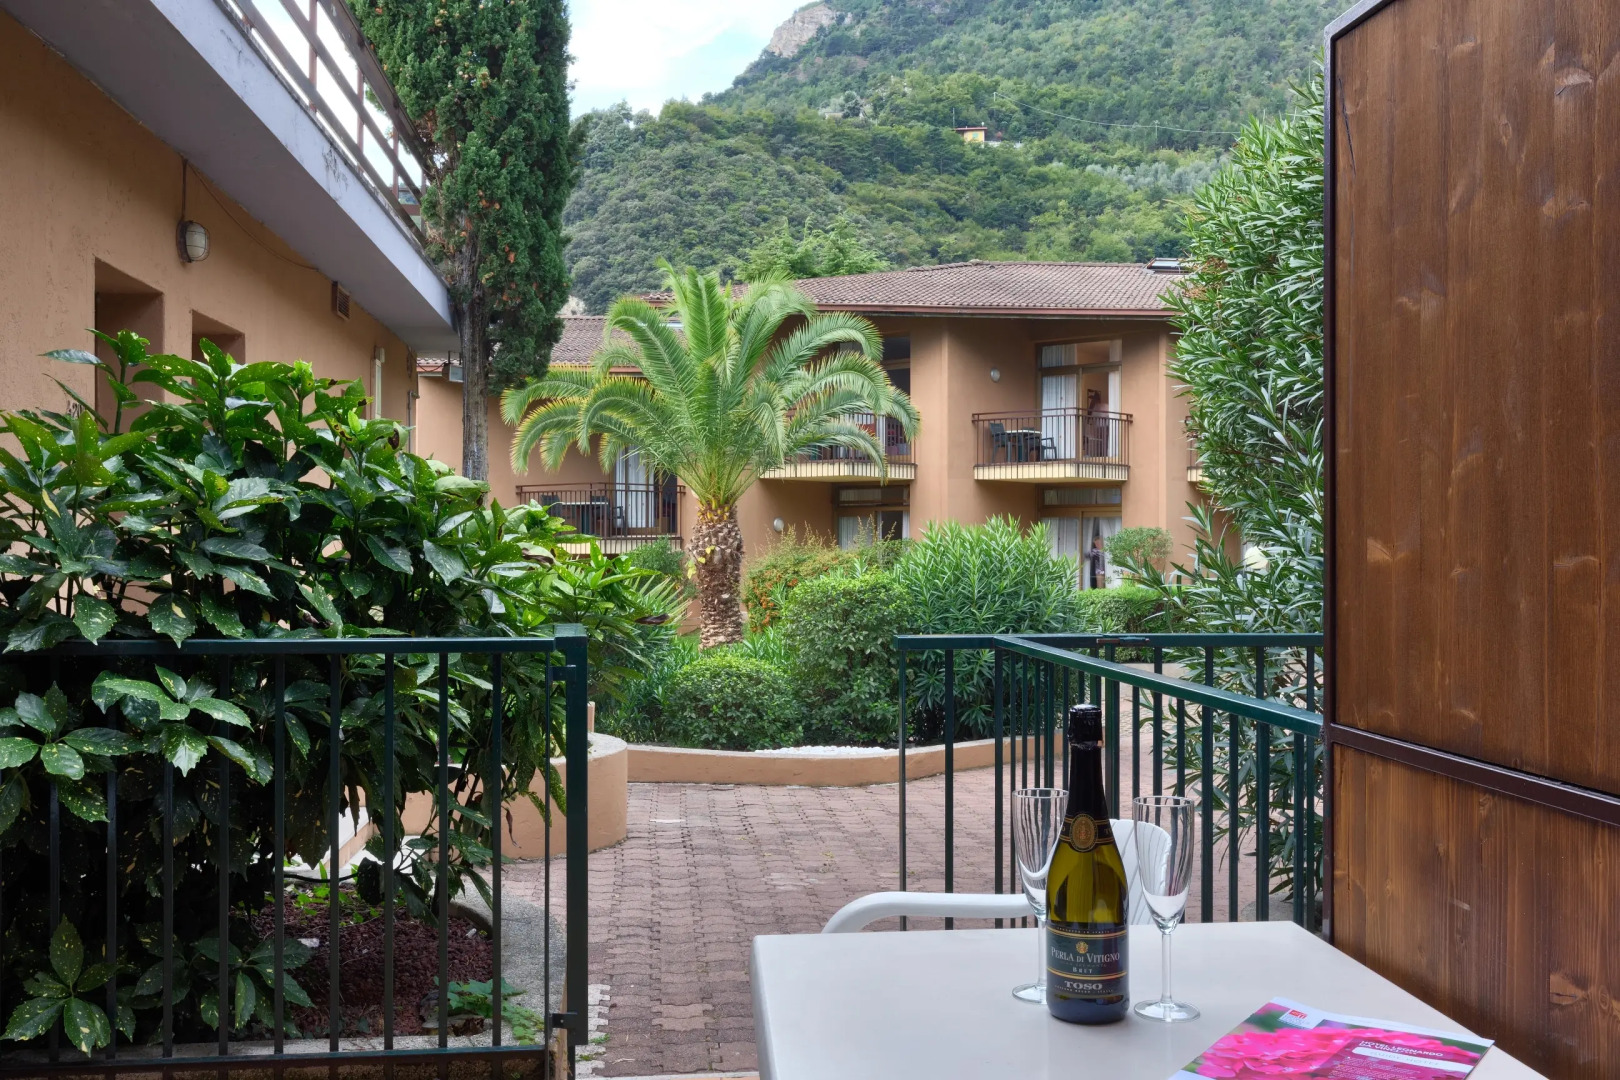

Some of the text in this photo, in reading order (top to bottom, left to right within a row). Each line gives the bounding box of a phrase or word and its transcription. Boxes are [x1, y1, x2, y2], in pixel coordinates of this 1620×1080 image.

[1051, 946, 1120, 963] PERLA DI VITIGNO
[1072, 966, 1093, 974] BRUT
[1064, 980, 1103, 990] TOSO
[1391, 1046, 1444, 1057] LEONARDO
